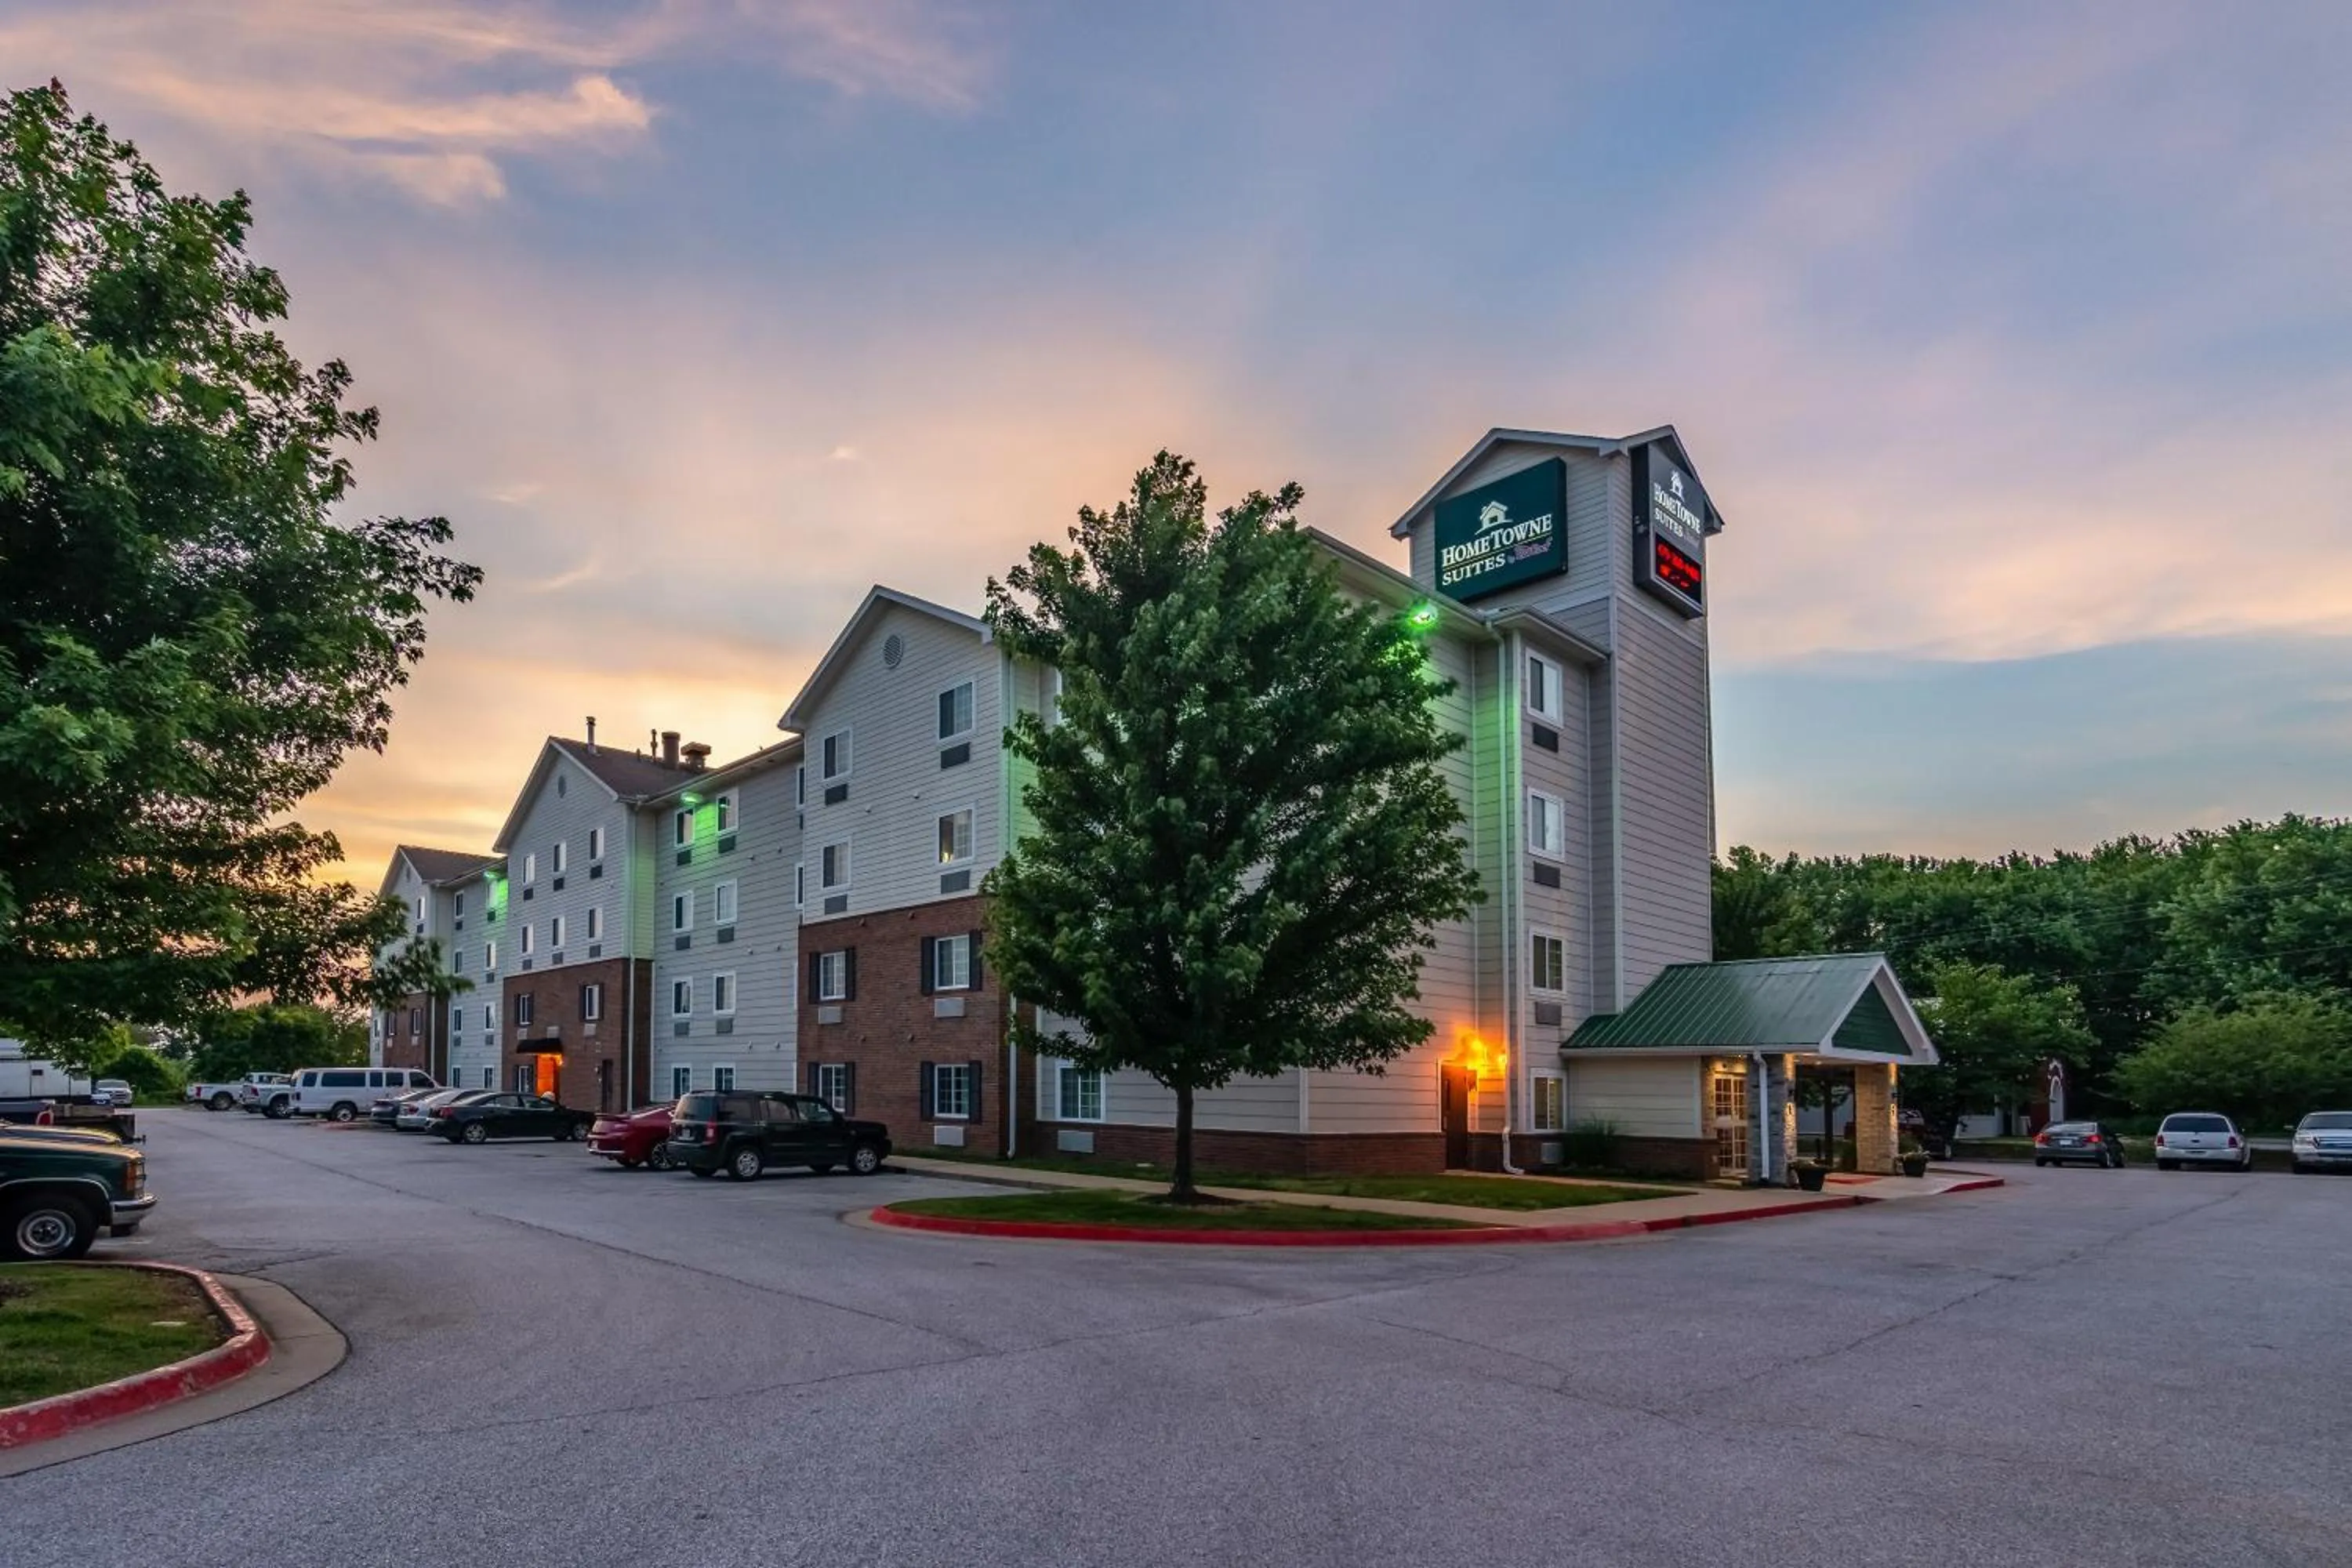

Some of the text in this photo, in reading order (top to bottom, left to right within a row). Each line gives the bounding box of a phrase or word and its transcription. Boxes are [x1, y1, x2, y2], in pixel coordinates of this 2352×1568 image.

[1655, 507, 1683, 537] SUITES
[1441, 514, 1553, 567] HOMETOWNE
[1442, 553, 1506, 586] SUITES
